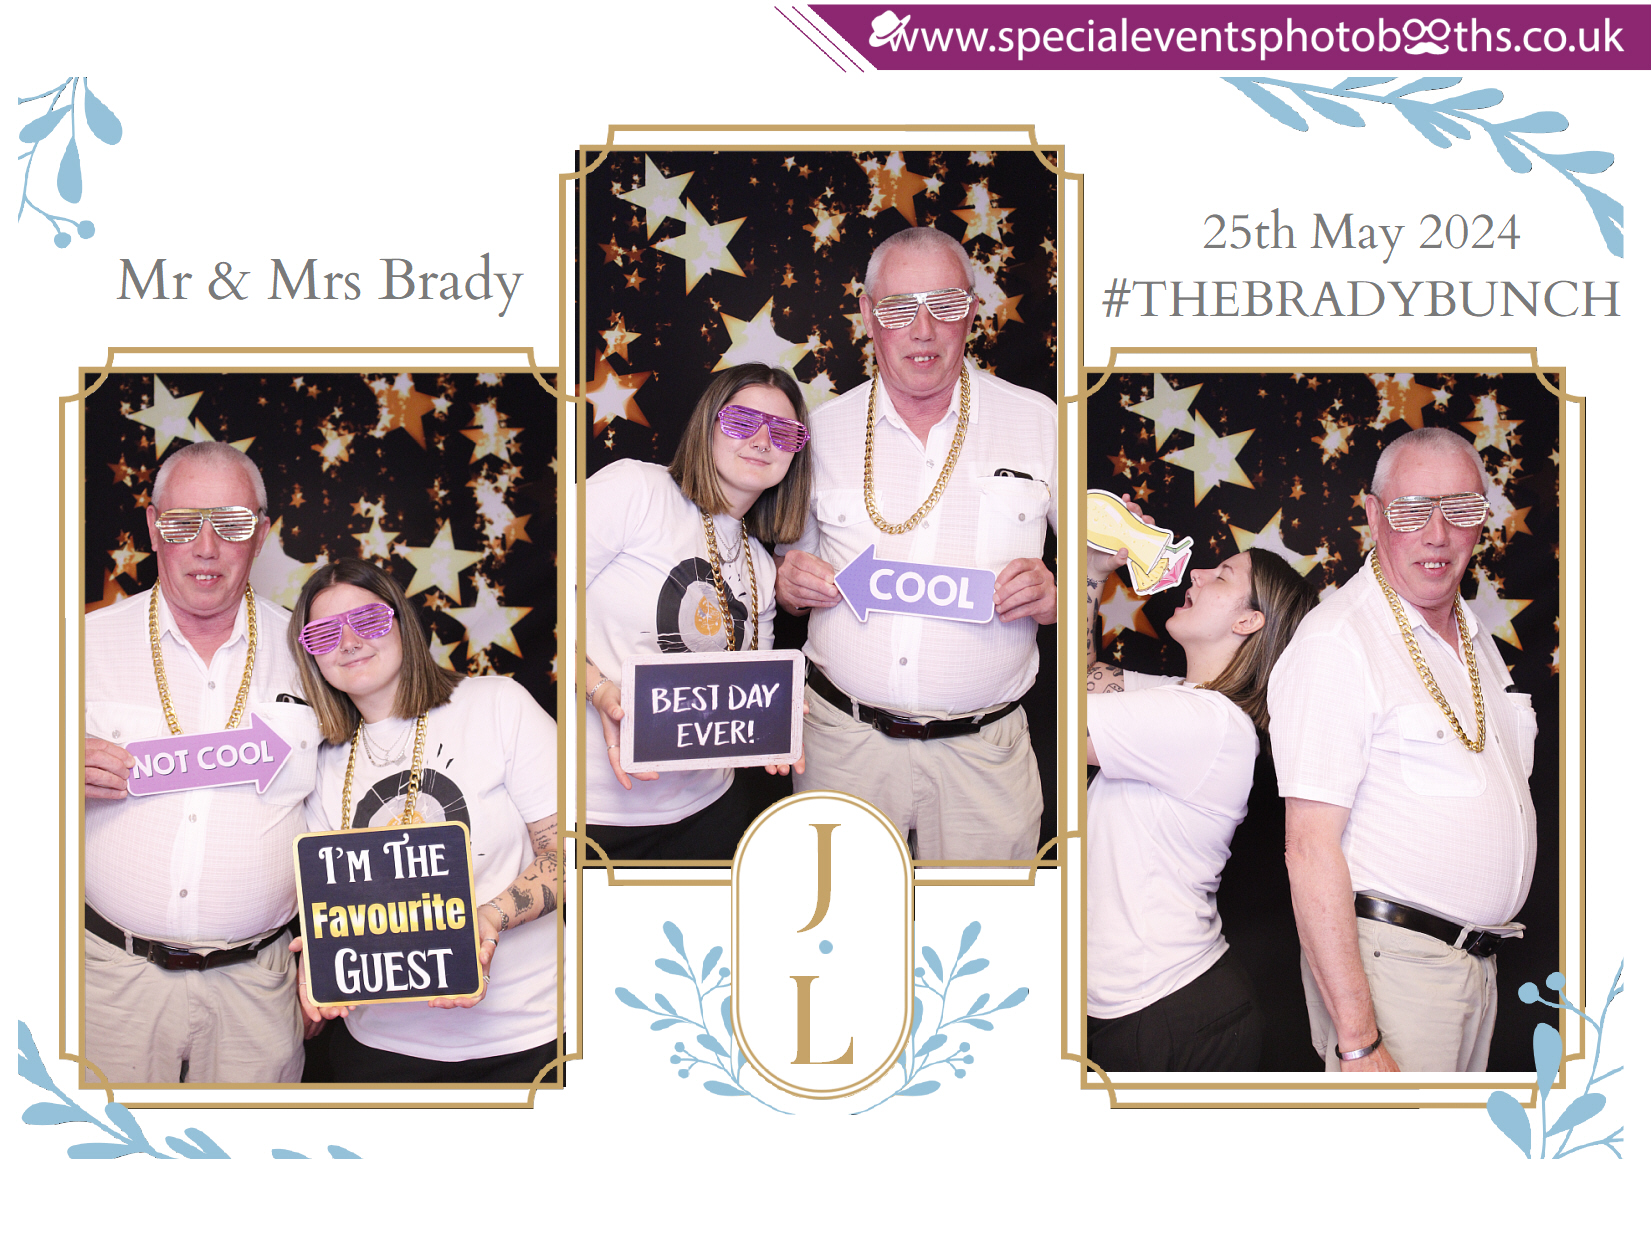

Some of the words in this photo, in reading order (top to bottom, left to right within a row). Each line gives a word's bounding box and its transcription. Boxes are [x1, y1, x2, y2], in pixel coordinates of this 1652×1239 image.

[869, 568, 974, 610] COOL
[651, 684, 720, 715] BEST
[728, 682, 780, 711] DAY
[676, 720, 755, 748] EVER!
[133, 749, 189, 779] NOT
[197, 740, 275, 770] COOL
[318, 846, 373, 885] I'M
[382, 832, 450, 880] THE
[311, 892, 466, 939] Favourite
[334, 947, 453, 994] GUEST
